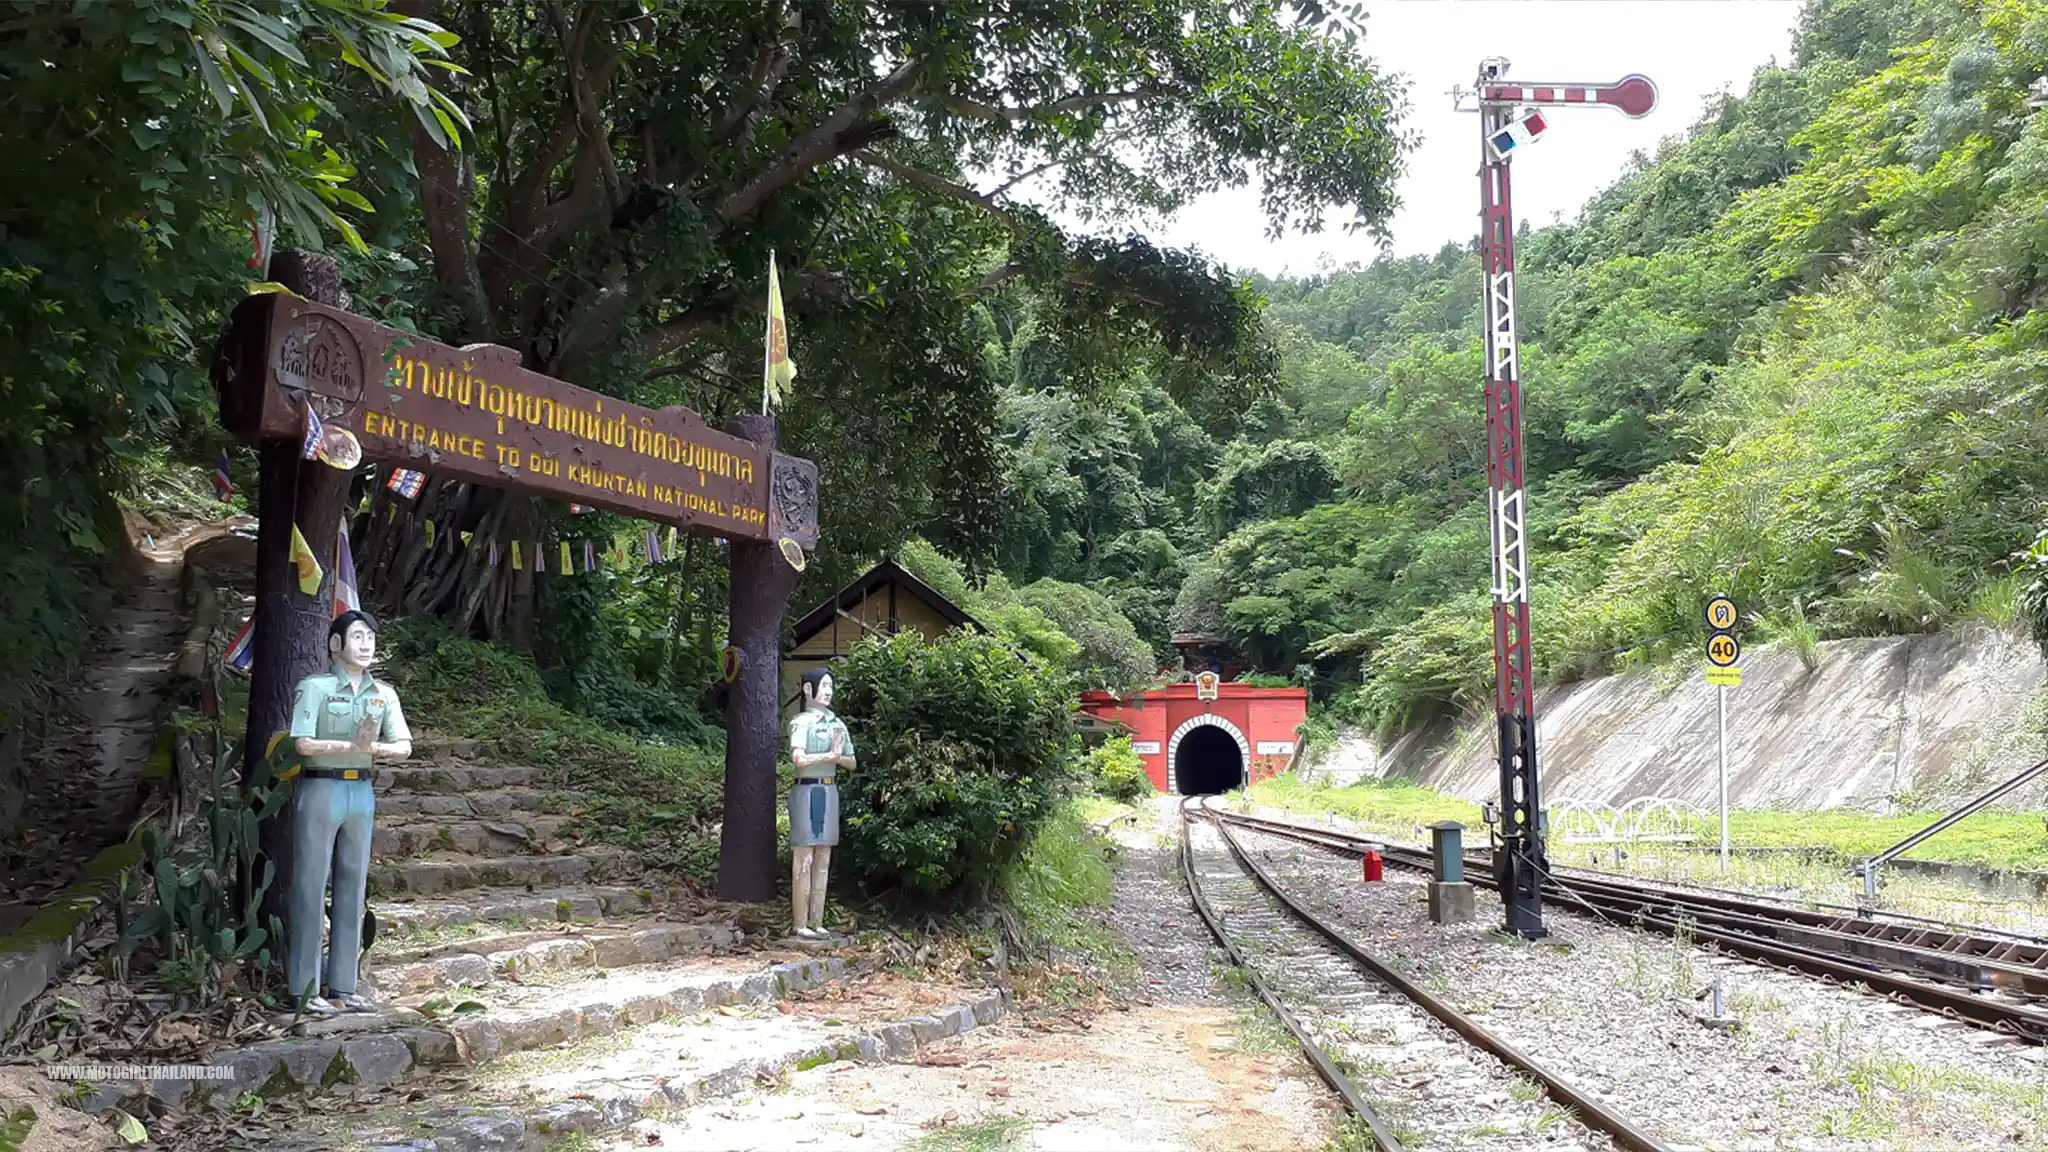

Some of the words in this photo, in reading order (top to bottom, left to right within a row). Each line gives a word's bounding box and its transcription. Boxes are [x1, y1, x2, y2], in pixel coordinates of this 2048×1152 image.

[365, 411, 487, 460] ENTRANCE
[496, 444, 520, 467] TO
[530, 452, 560, 477] DOI
[568, 464, 648, 498] KHUNTAN
[654, 485, 727, 517] NATIONAL
[732, 504, 767, 527] PARK
[394, 355, 753, 487] ทางเข้าอุทยานแห่งชาติดอยขุนตาล
[1711, 641, 1734, 657] 40
